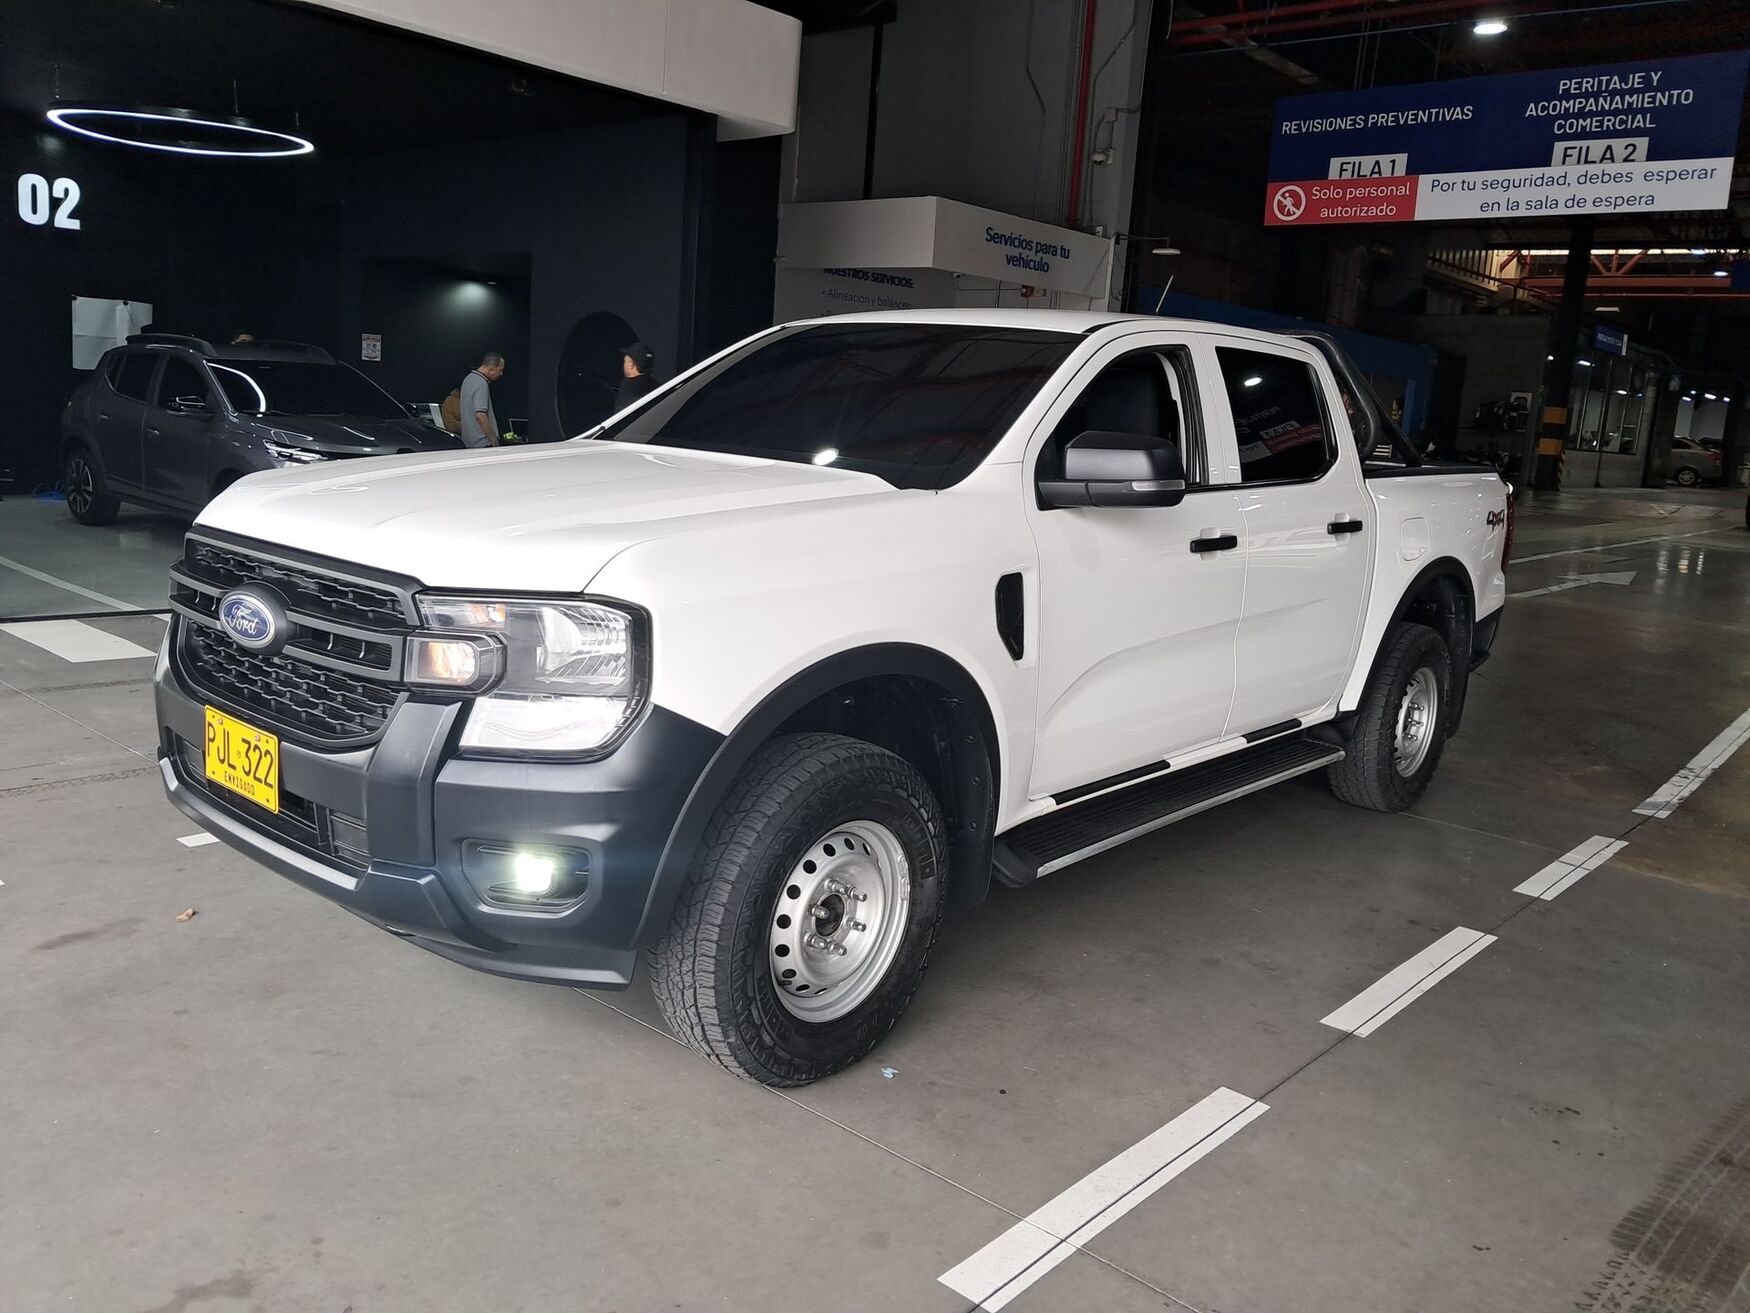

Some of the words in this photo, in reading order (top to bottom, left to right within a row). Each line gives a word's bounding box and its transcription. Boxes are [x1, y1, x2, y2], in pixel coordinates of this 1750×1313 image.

[1558, 73, 1645, 94] PERITAJE
[1650, 71, 1662, 87] Y
[1525, 89, 1694, 117] ACOMPAÑAMIENTO
[1281, 115, 1365, 135] REVISIONES
[1368, 106, 1473, 128] PREVENTIVAS
[1553, 113, 1656, 134] COMERCIAL
[1561, 145, 1615, 165] FILA
[1622, 143, 1638, 163] 2
[1338, 160, 1382, 178] FILA
[1389, 158, 1397, 177] 1
[1431, 178, 1457, 193] Por
[1460, 178, 1476, 192] tu
[1481, 172, 1571, 193] seguridad,
[1576, 170, 1634, 187] debes
[1643, 167, 1718, 185] esperar
[17, 172, 82, 231] 02
[1312, 186, 1343, 200] Solo
[1346, 182, 1410, 200] personal
[1480, 200, 1501, 213] en
[1506, 197, 1520, 212] la
[1525, 196, 1559, 211] sala
[1564, 195, 1587, 209] de
[1592, 193, 1655, 212] espera
[1320, 203, 1397, 218] autorizado
[985, 226, 1033, 252] Servicios
[1035, 241, 1057, 257] para
[1060, 245, 1070, 259] tu
[1005, 252, 1049, 273] vehículo
[229, 604, 259, 635] Ford
[207, 721, 237, 771] PJL
[241, 737, 274, 789] 322
[224, 770, 256, 796] ENVIGADO
